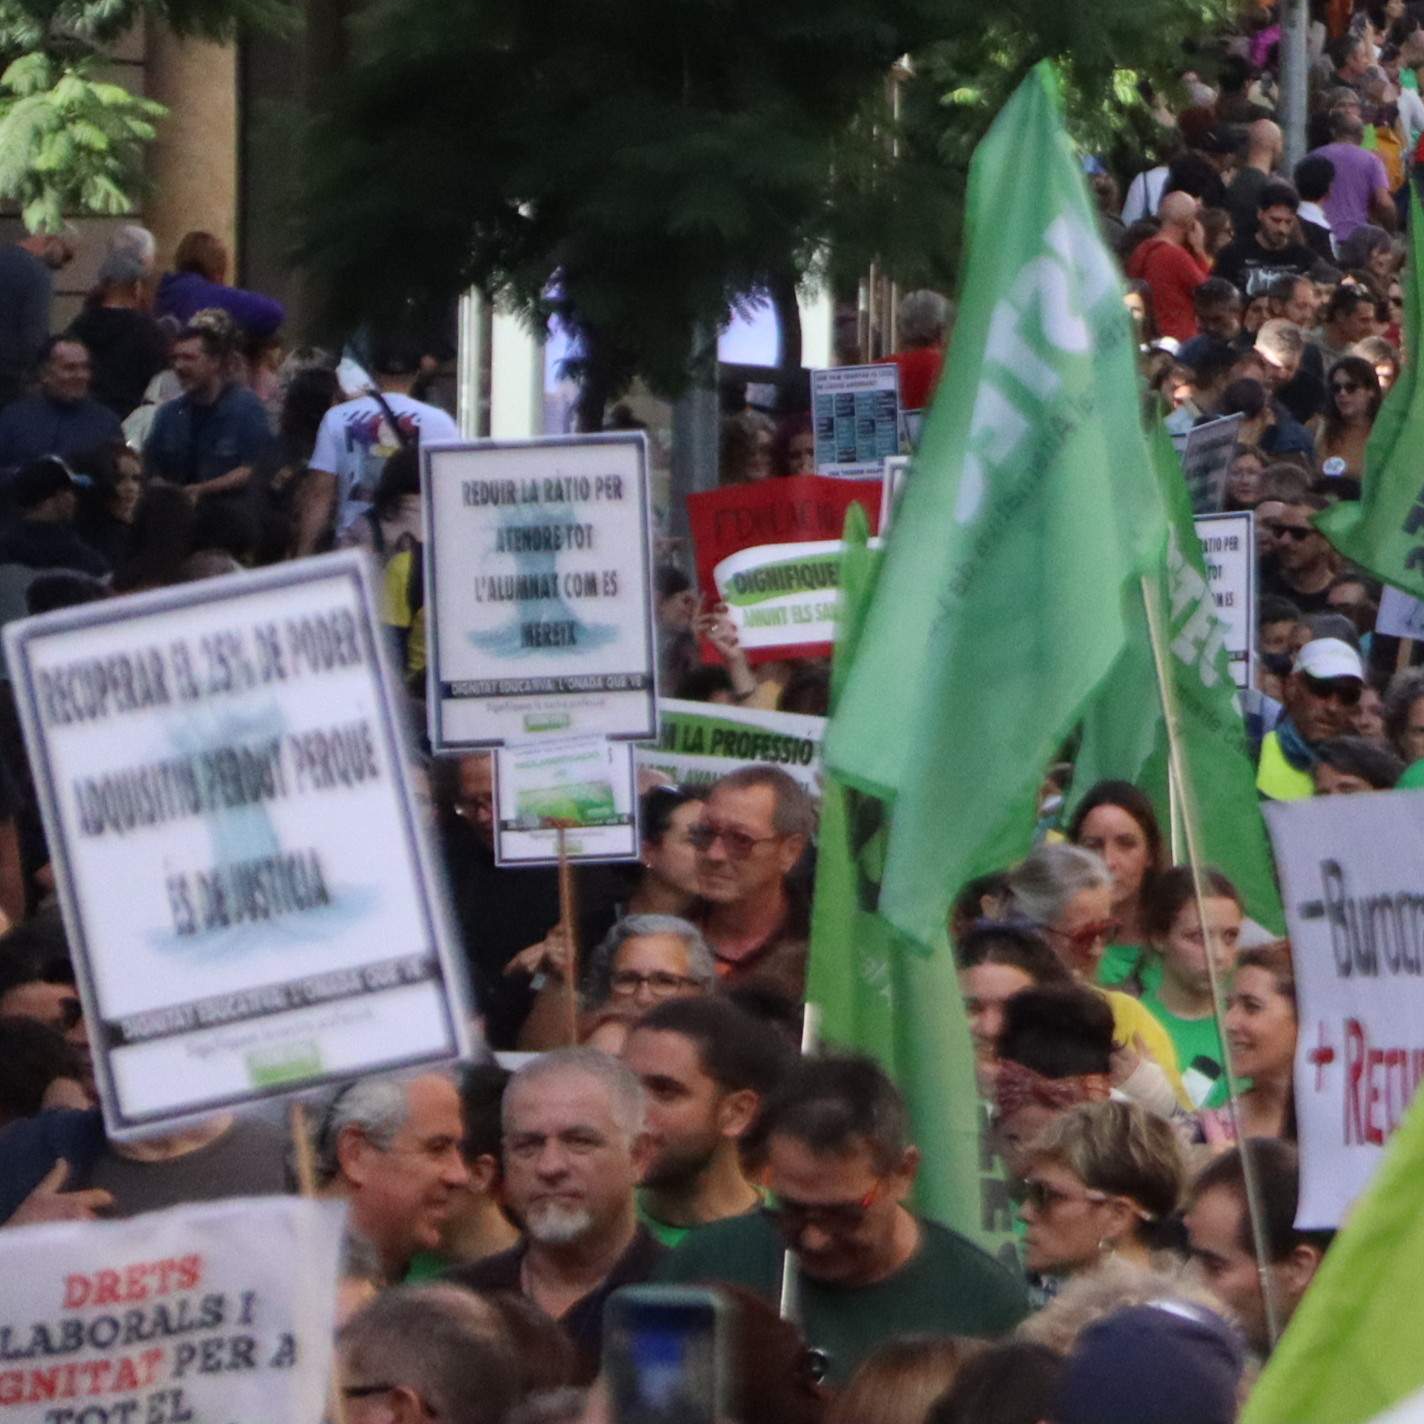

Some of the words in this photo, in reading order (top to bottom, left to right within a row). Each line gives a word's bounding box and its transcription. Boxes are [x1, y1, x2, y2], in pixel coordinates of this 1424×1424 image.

[462, 478, 518, 507] REDUIR
[519, 478, 539, 505] LA
[595, 474, 623, 502] PER
[564, 523, 594, 551] TOT
[563, 571, 599, 600] COM
[602, 569, 619, 597] ES
[733, 560, 843, 595] DIGNIFIQUE
[288, 606, 363, 672] PODER
[62, 1252, 204, 1311] DRETS
[236, 1289, 258, 1326] I
[171, 1333, 257, 1378] PER
[269, 1331, 297, 1369] A
